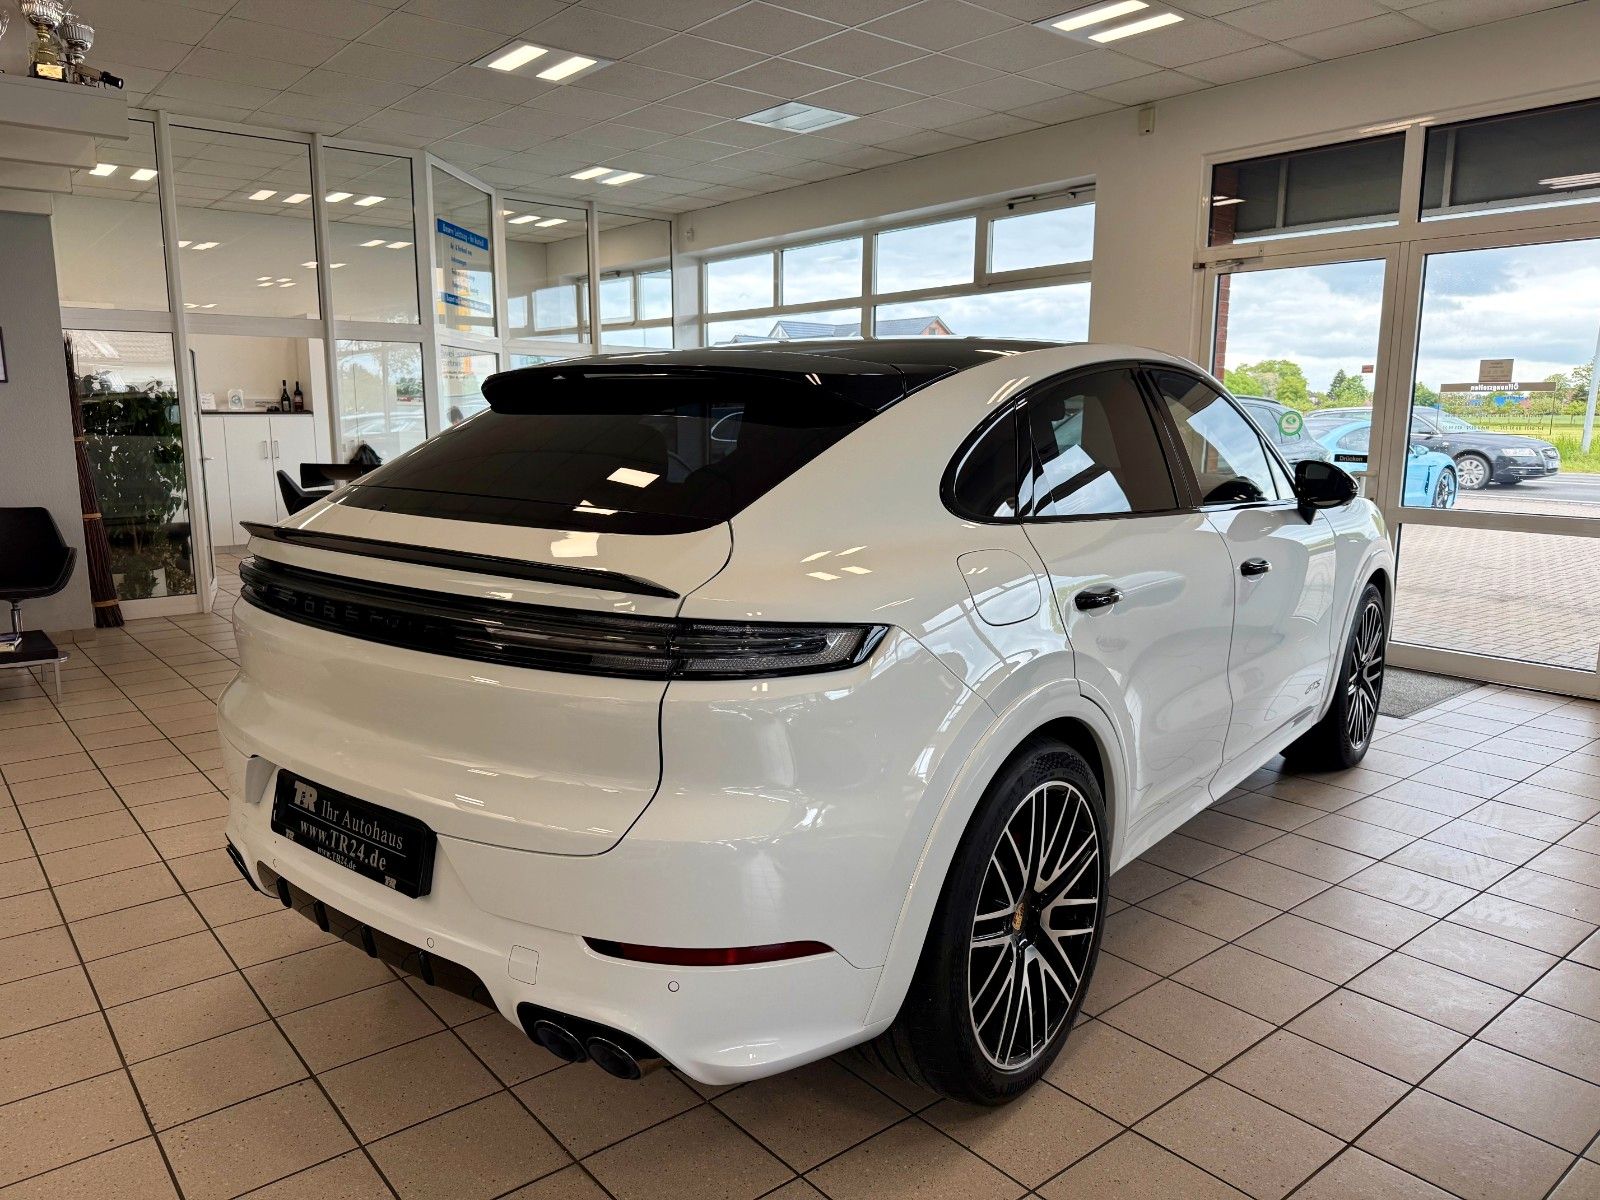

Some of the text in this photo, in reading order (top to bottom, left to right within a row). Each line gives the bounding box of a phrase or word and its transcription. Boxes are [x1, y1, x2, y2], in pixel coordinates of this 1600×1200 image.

[293, 780, 318, 813] TR
[300, 820, 387, 871] www.TR24.de
[321, 800, 403, 850] Ihr Autohaus
[317, 846, 357, 870] www.TR24.de
